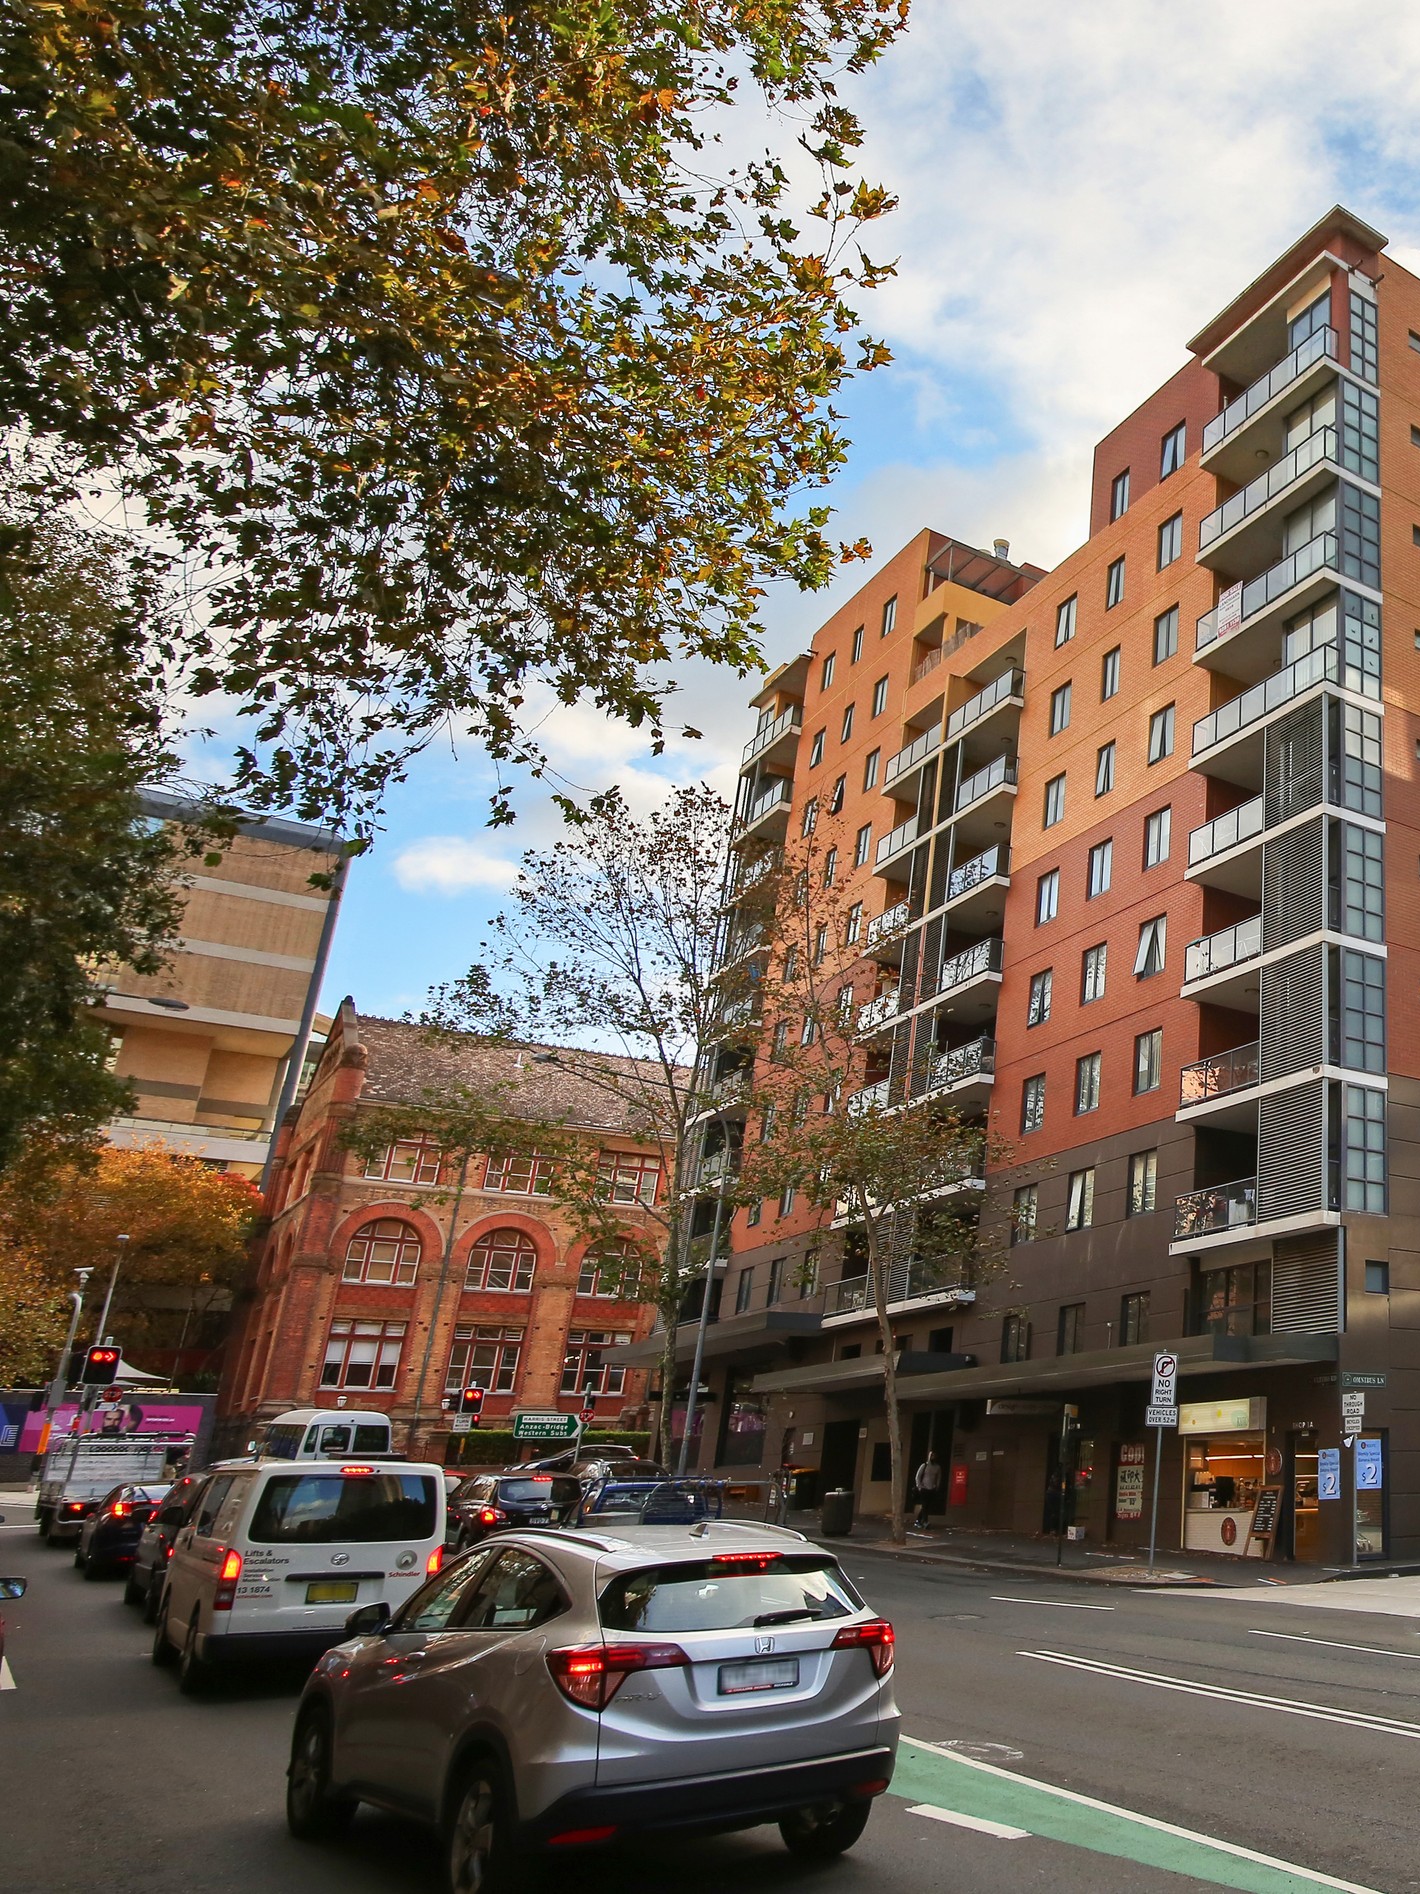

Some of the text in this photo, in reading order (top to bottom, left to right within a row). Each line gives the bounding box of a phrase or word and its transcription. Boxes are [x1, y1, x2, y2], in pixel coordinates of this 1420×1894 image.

[1158, 1379, 1171, 1388] NO
[266, 1549, 273, 1557] &
[243, 1557, 290, 1565] Escalators
[237, 1586, 248, 1594] 13
